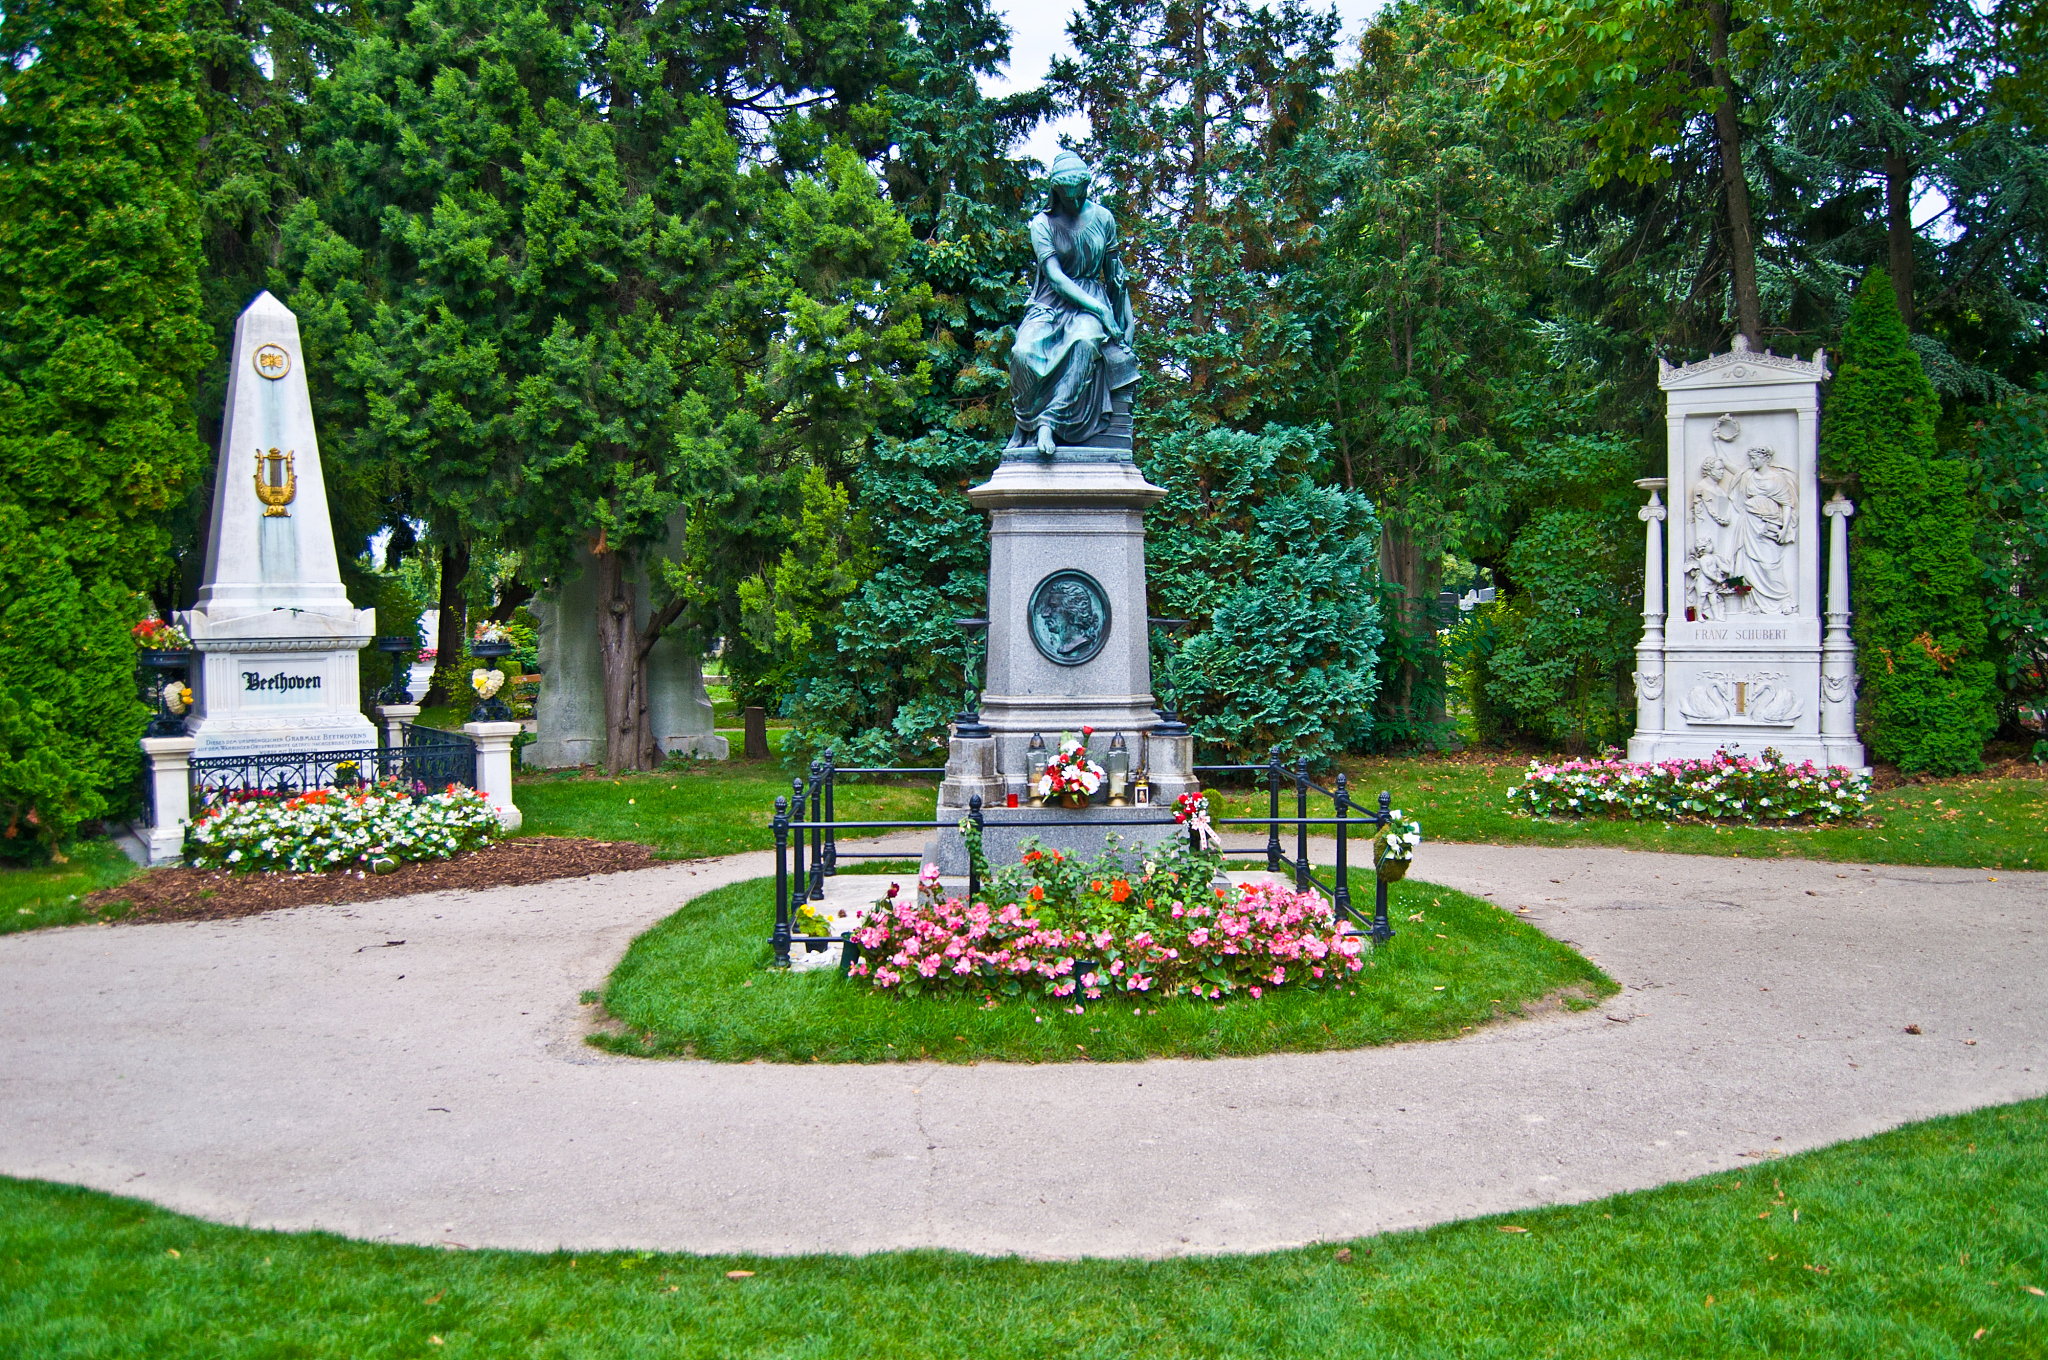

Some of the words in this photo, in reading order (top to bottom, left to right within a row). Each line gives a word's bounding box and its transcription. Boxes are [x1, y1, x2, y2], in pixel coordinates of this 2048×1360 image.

[1695, 629, 1728, 640] FRANZ
[1735, 629, 1788, 640] SCHUBERT
[241, 671, 321, 693] Beethoven
